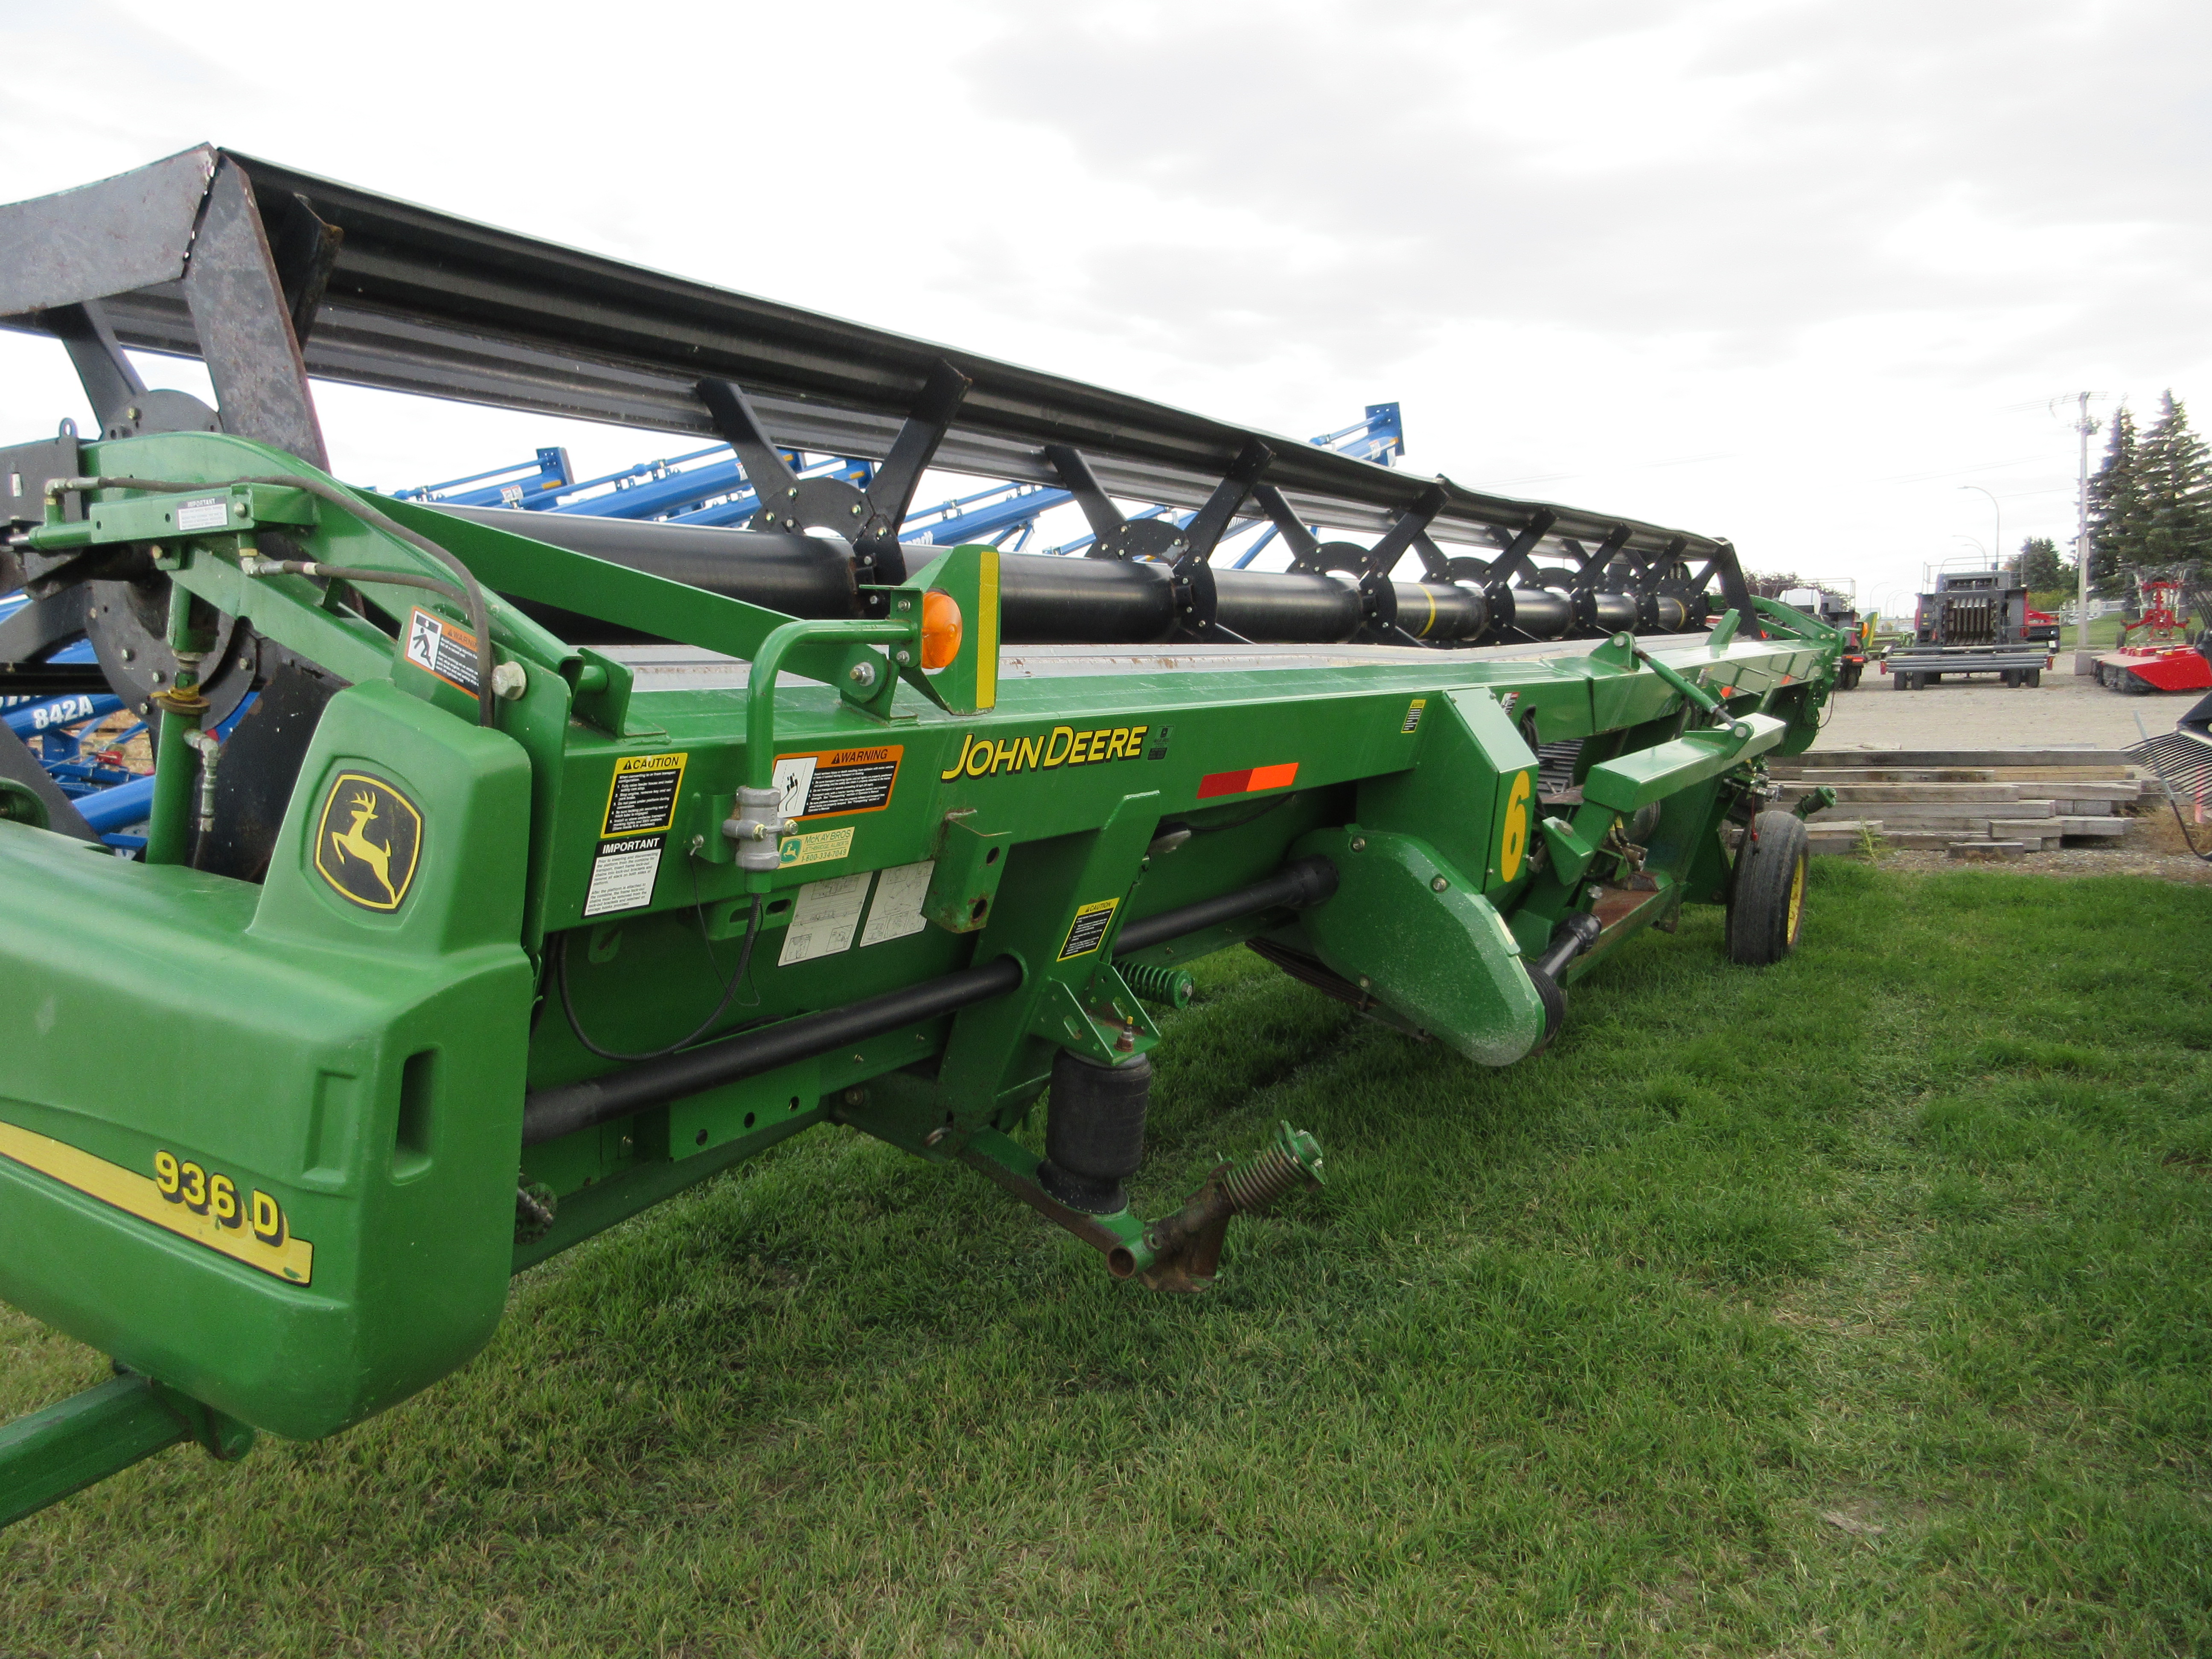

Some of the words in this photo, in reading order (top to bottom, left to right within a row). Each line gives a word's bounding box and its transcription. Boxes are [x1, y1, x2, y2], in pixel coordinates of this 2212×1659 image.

[33, 696, 94, 729] 842A
[841, 749, 888, 763] WARNING
[940, 733, 1045, 782] JOHN
[1042, 725, 1149, 770] DEERE
[633, 757, 679, 769] CAUTION
[1501, 770, 1530, 883] 6
[602, 838, 661, 854] IMPORTANT
[801, 849, 847, 862] 1-800-334-7049
[1089, 901, 1112, 911] CAUTION
[155, 1150, 238, 1221] 936
[253, 1188, 281, 1237] D
